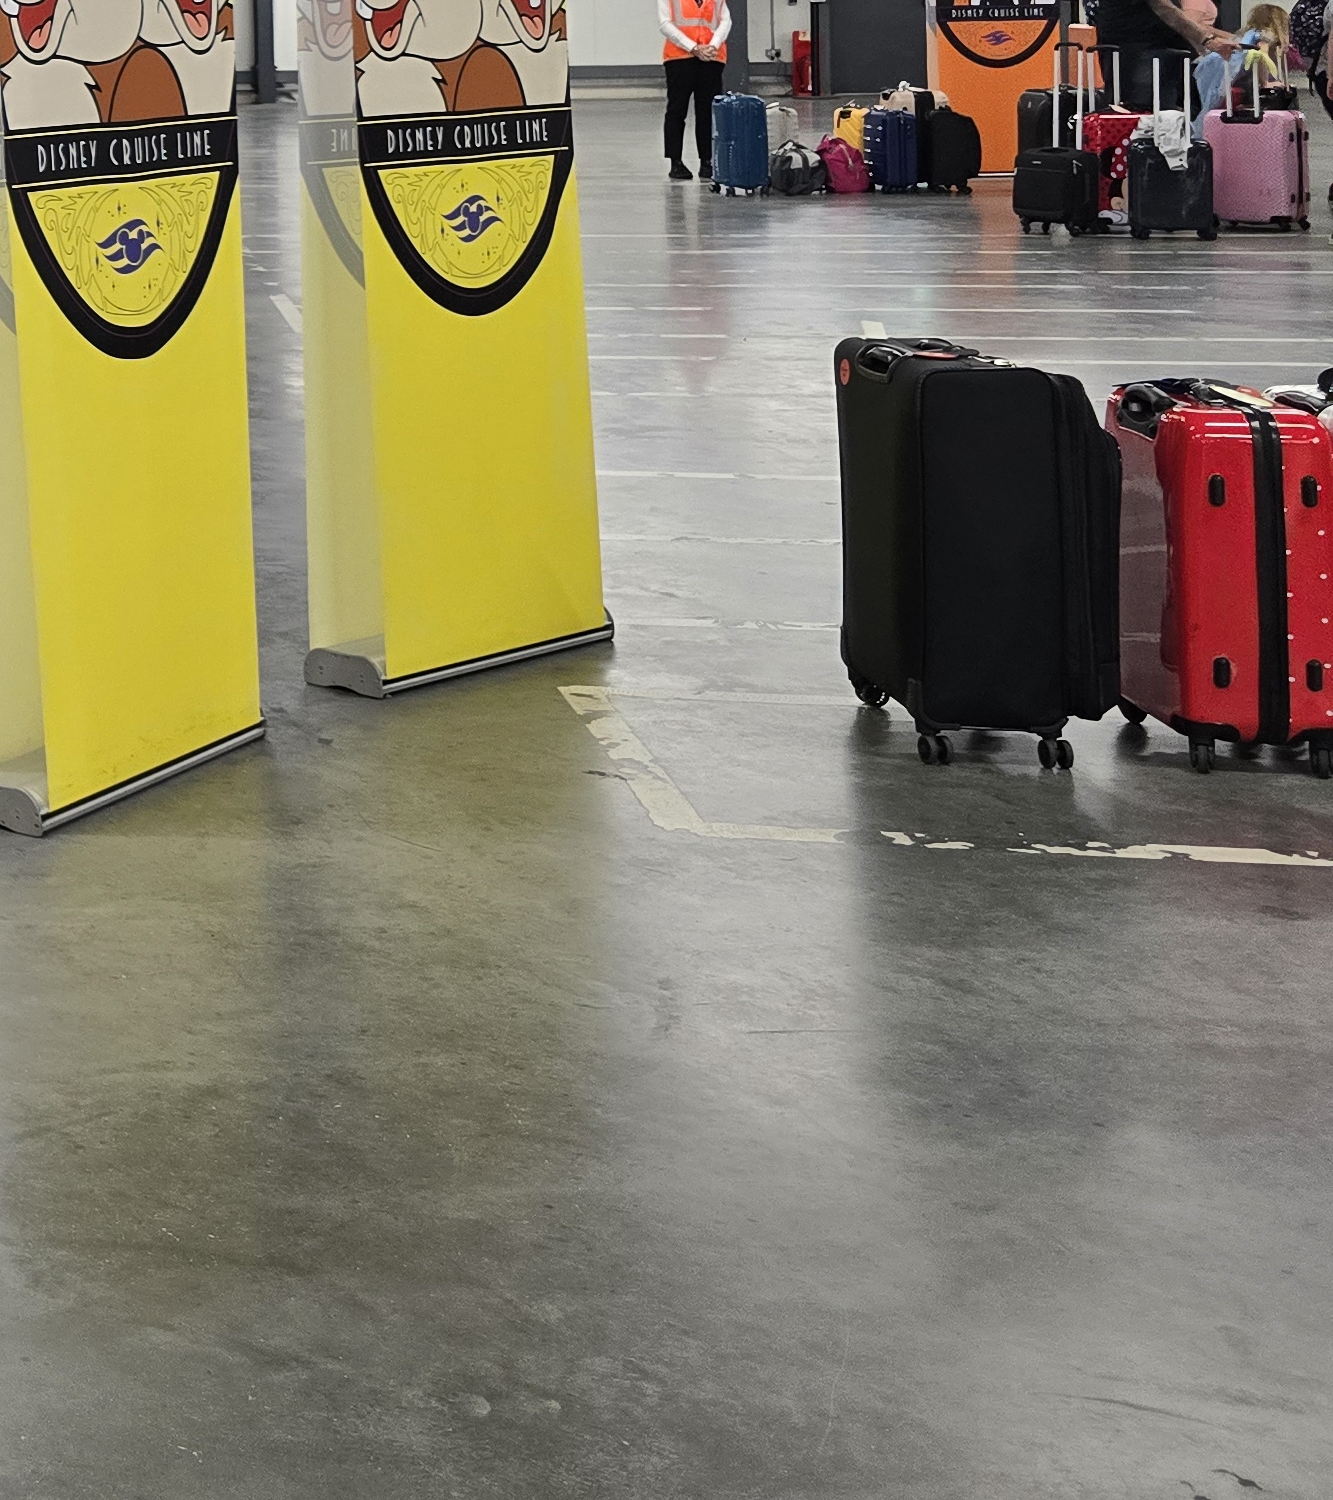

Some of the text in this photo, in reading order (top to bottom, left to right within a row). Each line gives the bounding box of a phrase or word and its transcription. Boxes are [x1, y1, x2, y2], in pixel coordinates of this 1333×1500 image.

[951, 7, 1044, 18] DISNEY CRUISE LINE
[37, 129, 212, 173] DISNEY CRUISE LINE
[386, 118, 549, 154] DISNEY CRUISE LINE
